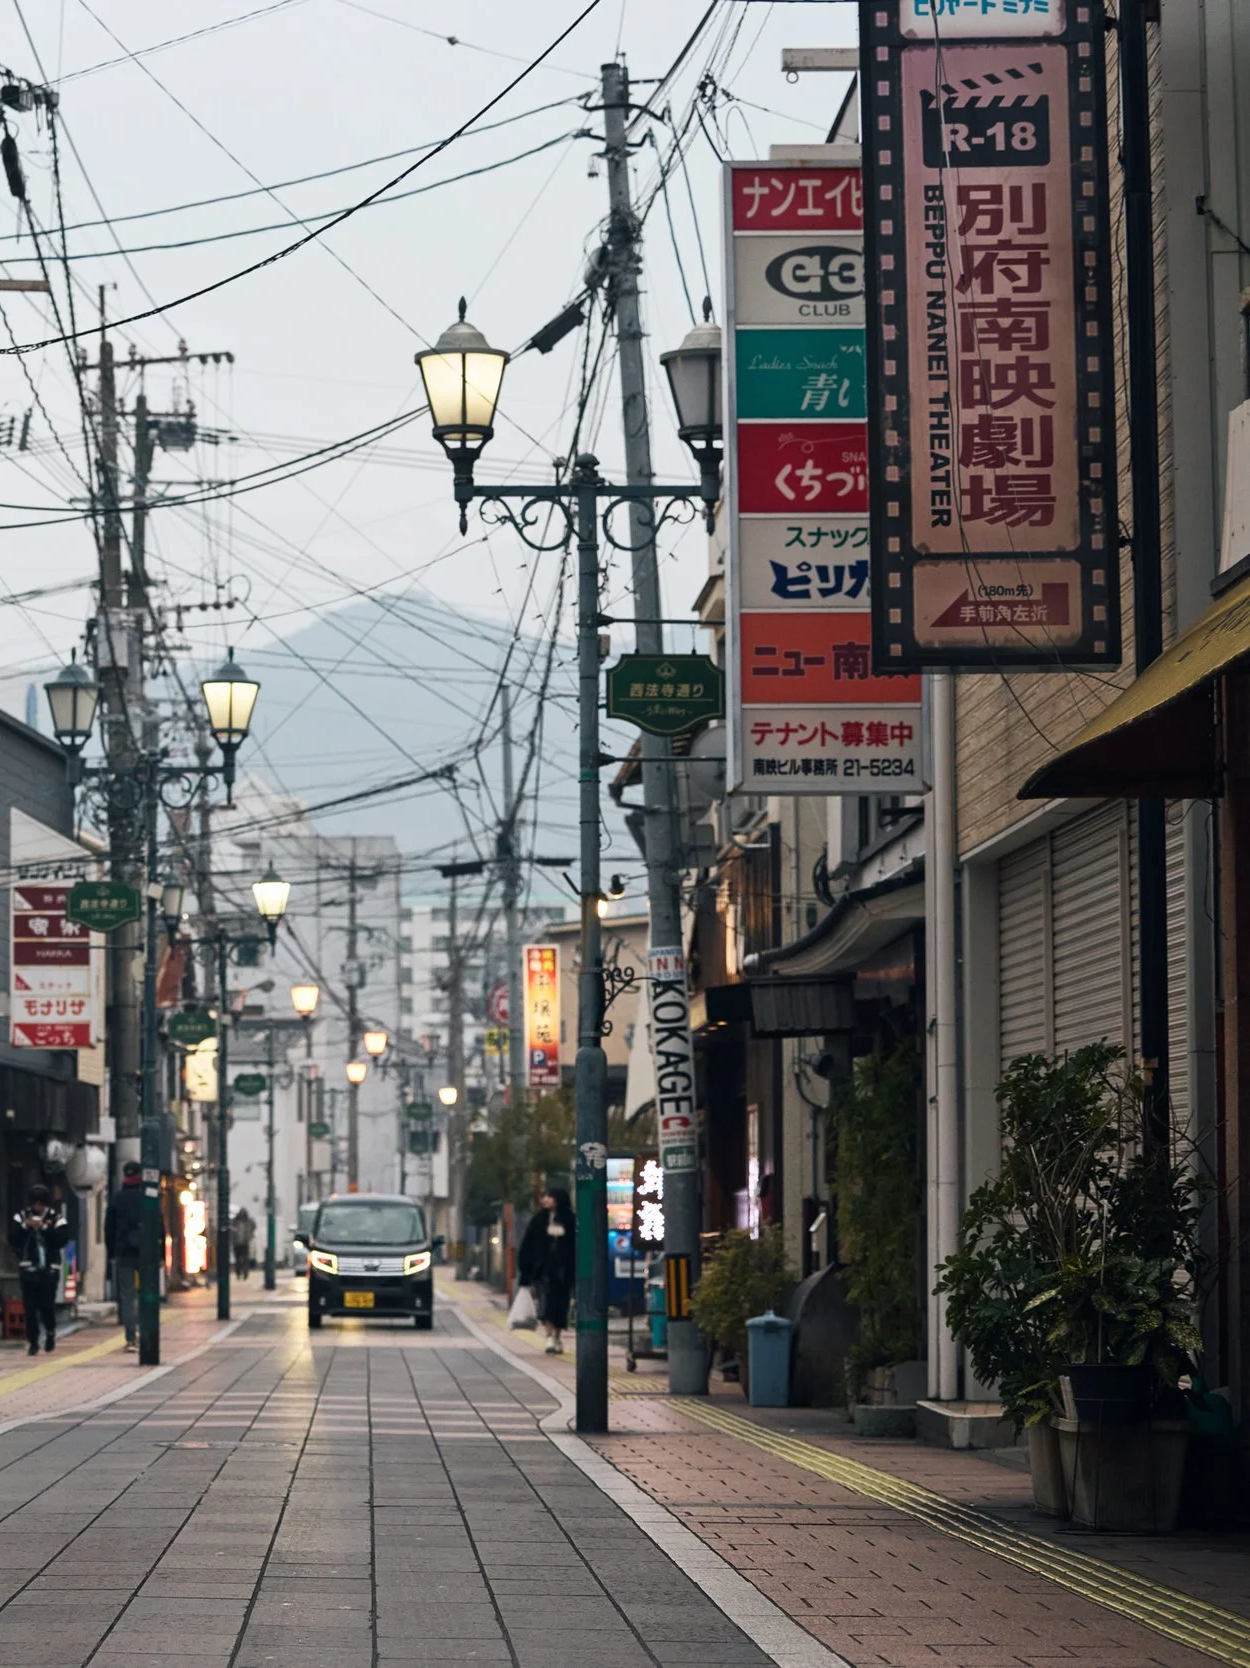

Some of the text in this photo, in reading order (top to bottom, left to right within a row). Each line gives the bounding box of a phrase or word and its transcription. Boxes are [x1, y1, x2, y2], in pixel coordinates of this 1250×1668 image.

[942, 121, 1037, 152] R-18
[799, 303, 851, 317] CLUB
[747, 353, 791, 370] Ladies
[923, 184, 952, 529] BEPPU NANEI THEATER
[955, 182, 1056, 528] 別府南映劇場
[785, 527, 869, 548] スナック
[960, 604, 1048, 622] 手前角左折
[751, 721, 913, 747] テナント募集中
[843, 758, 915, 777] 21-5234
[652, 979, 694, 1116] KOKAGE
